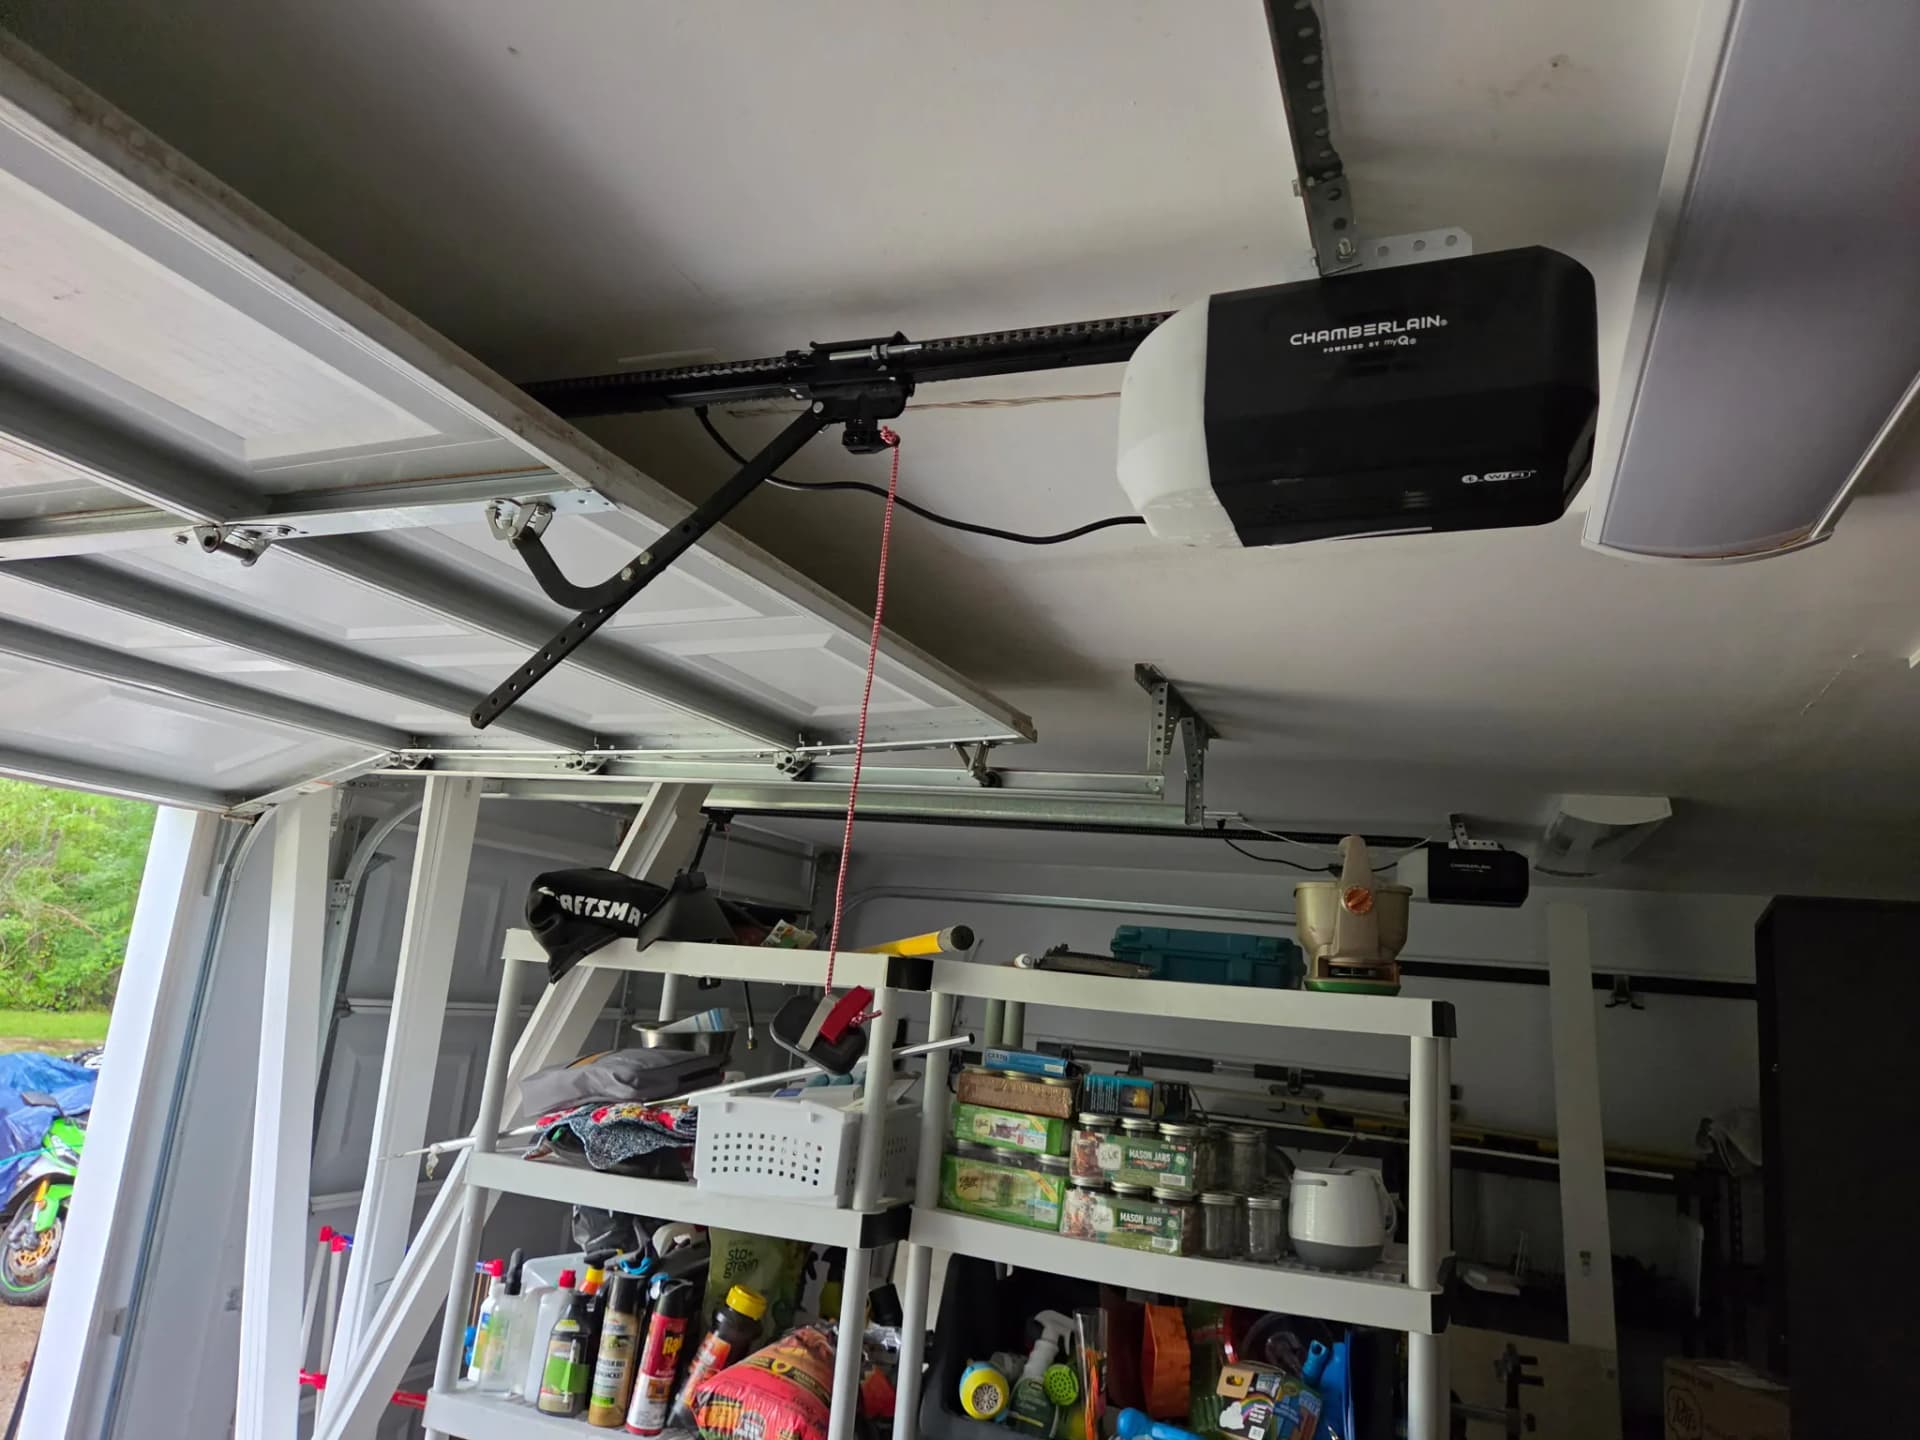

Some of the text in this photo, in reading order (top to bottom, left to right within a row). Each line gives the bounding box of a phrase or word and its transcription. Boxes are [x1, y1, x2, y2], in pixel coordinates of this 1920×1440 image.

[1128, 1148, 1153, 1161] MASON
[1154, 1151, 1171, 1163] JARS
[1120, 1212, 1144, 1224] MASON
[1145, 1215, 1162, 1226] JARS
